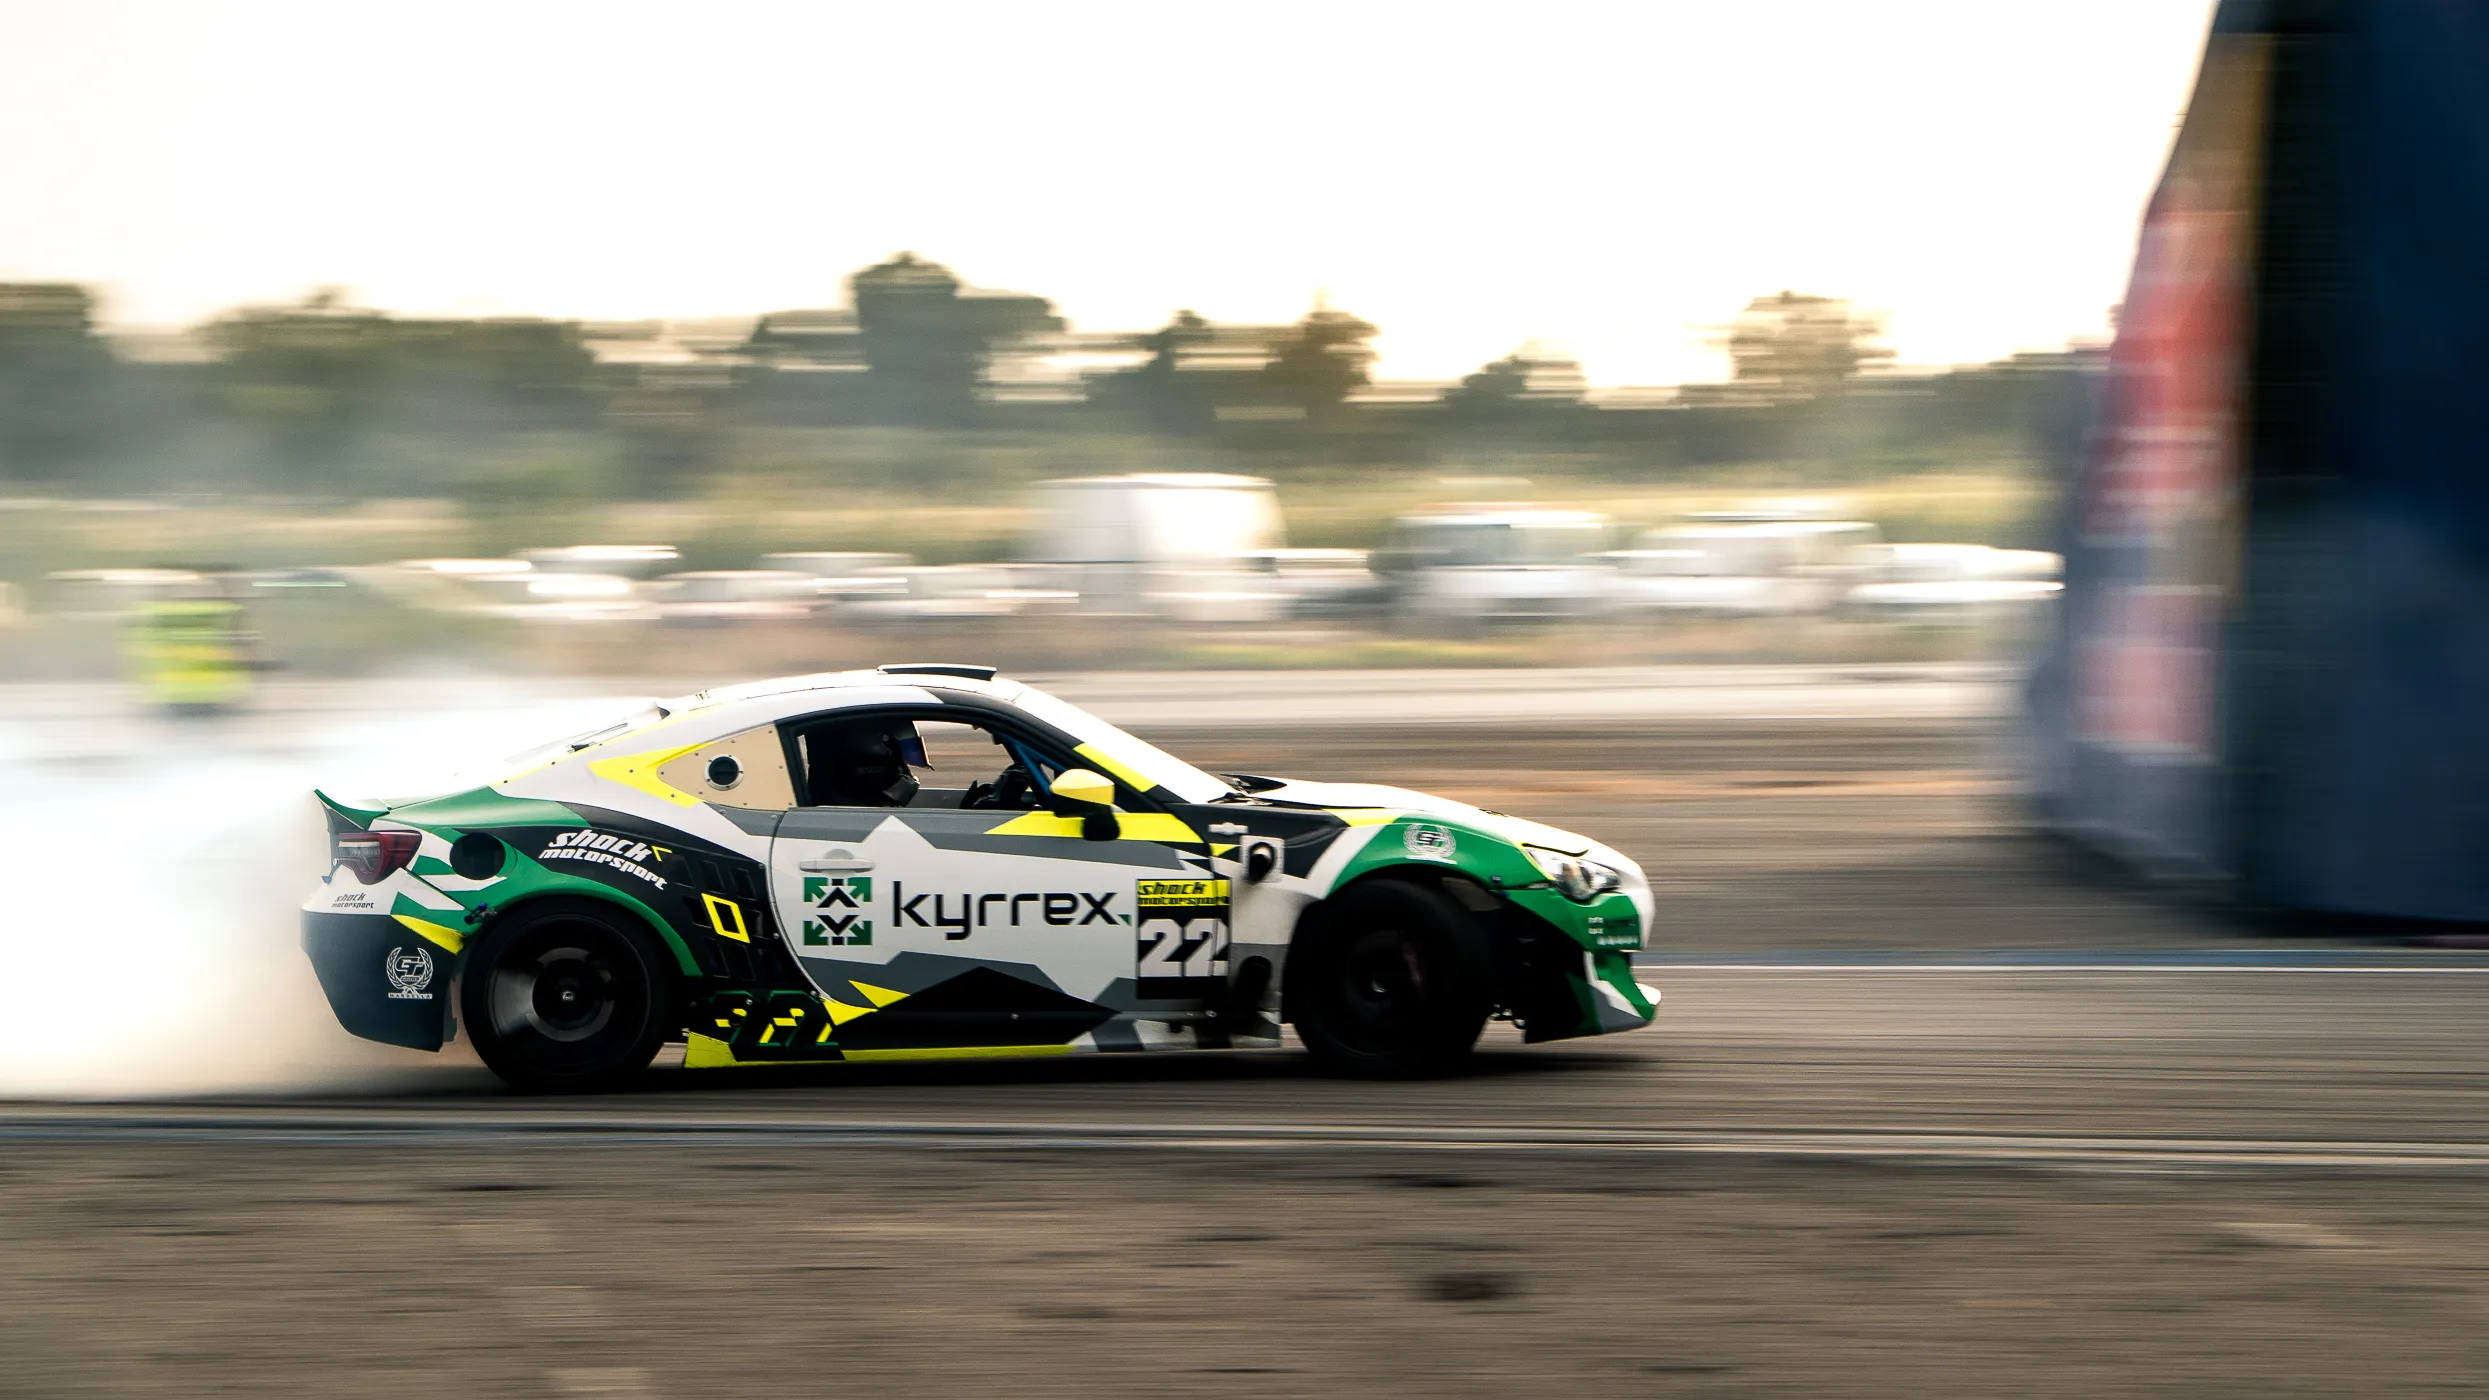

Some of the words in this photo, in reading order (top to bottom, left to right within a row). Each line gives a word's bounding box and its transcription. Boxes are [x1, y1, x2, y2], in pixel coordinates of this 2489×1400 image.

[548, 829, 652, 862] shock
[538, 848, 668, 890] motorsport
[334, 892, 367, 902] shock
[1138, 882, 1206, 896] shock
[892, 880, 1121, 941] kyrrex
[1139, 918, 1230, 977] 22
